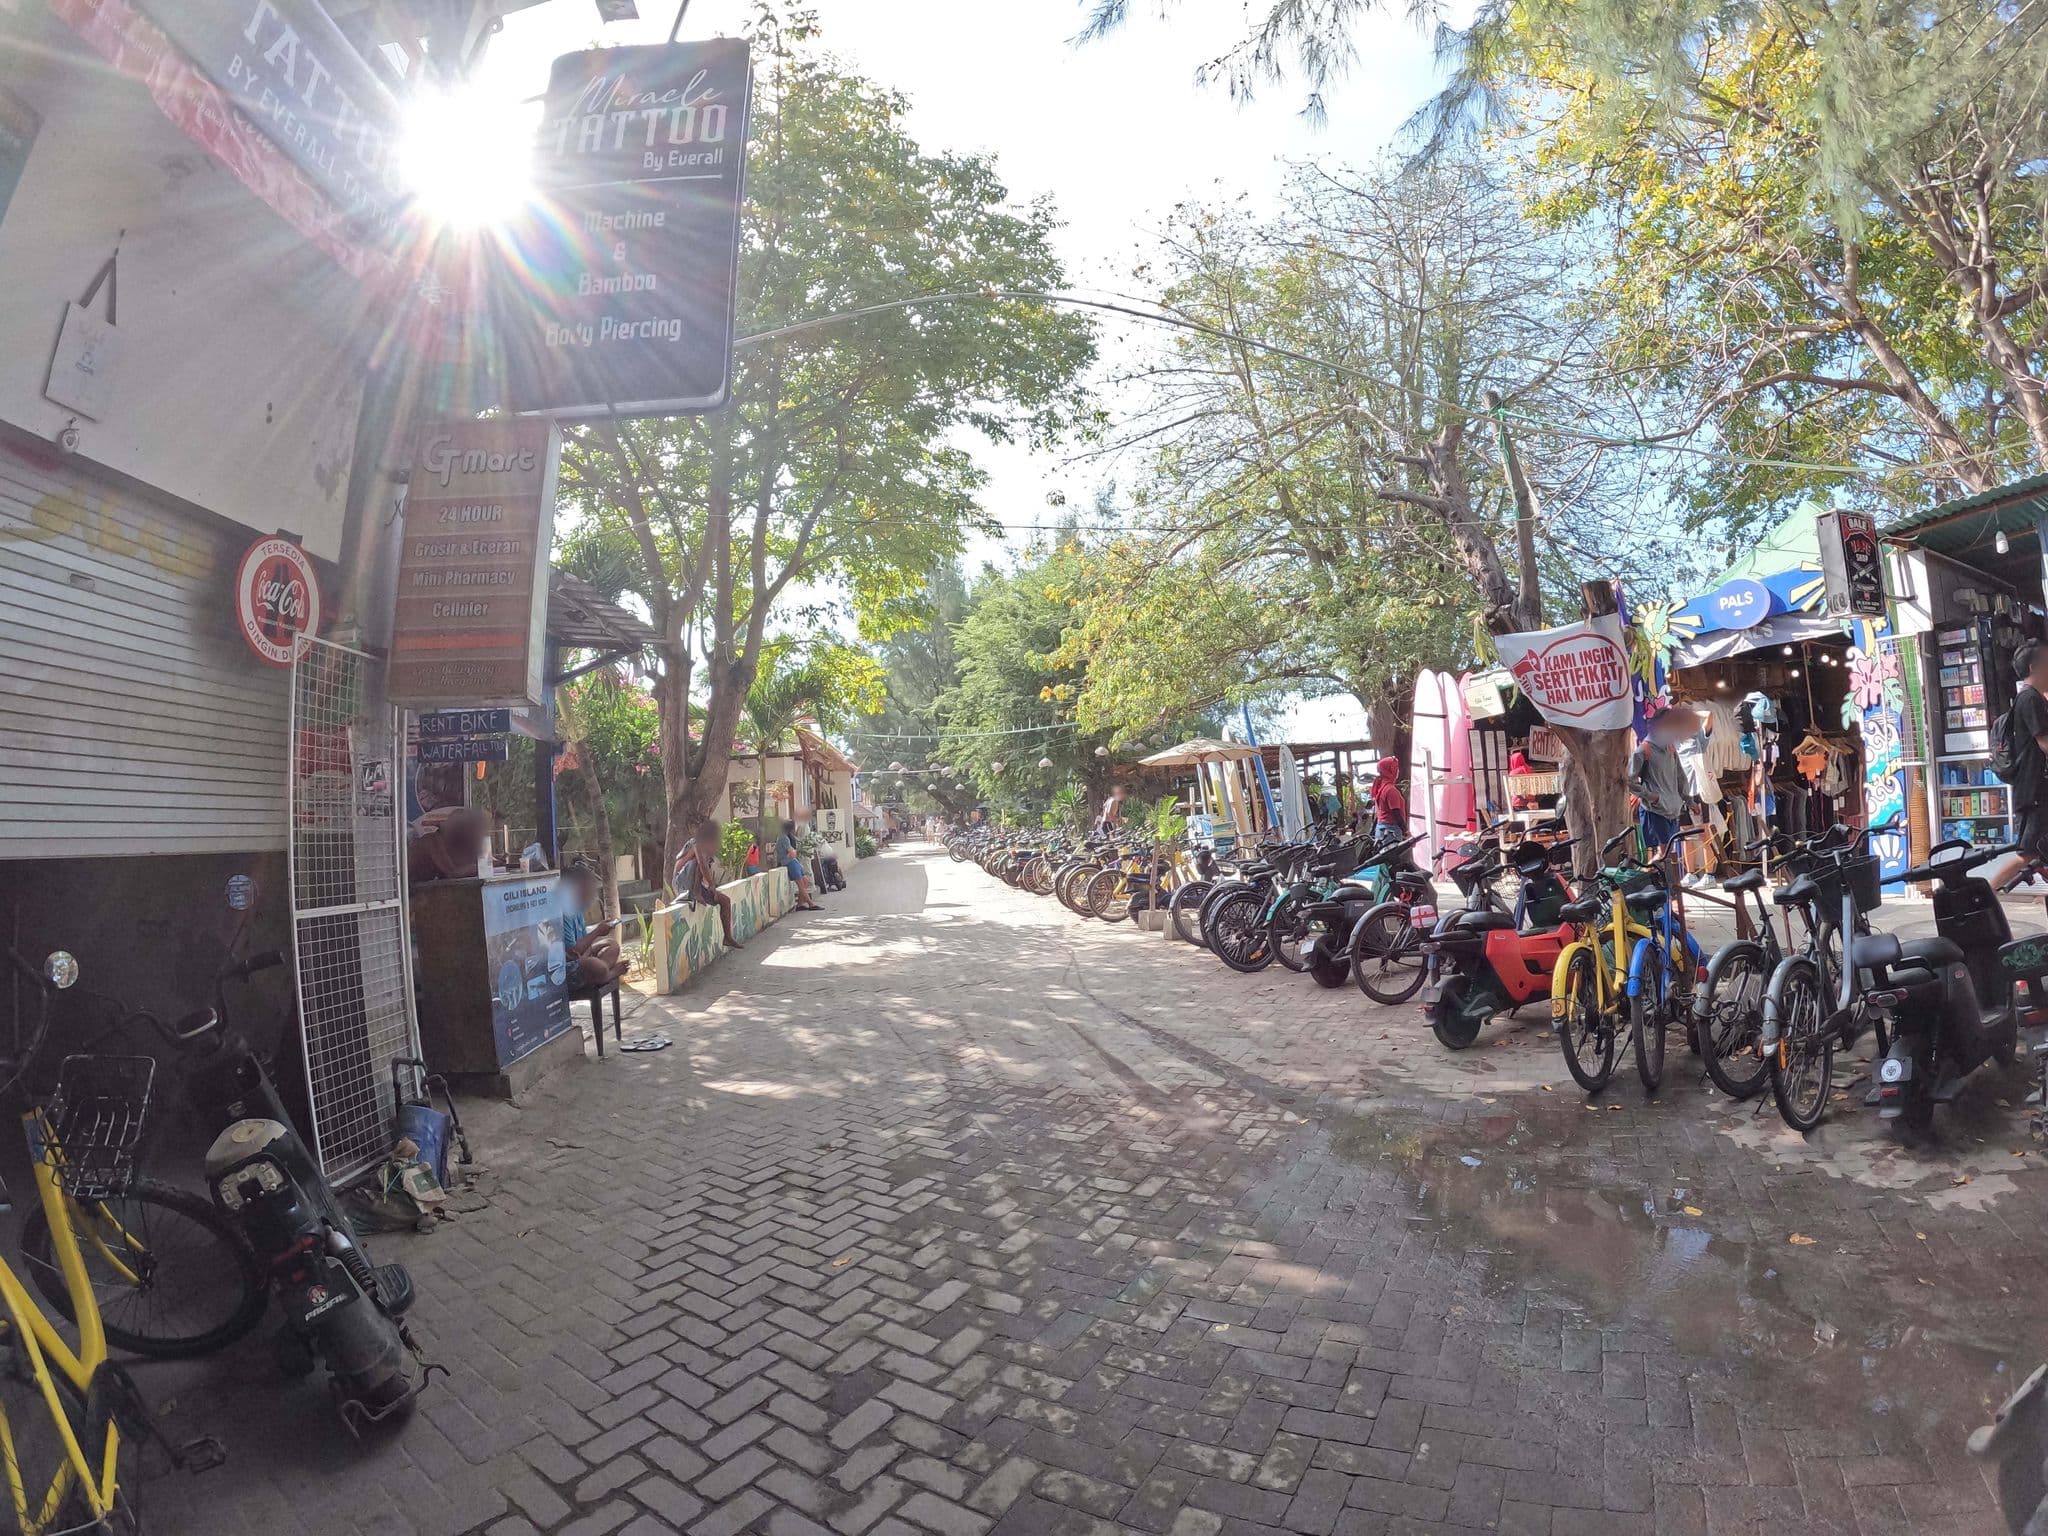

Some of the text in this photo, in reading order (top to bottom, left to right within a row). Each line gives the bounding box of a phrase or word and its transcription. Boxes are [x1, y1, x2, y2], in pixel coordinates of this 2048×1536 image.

[568, 68, 723, 119] Miracle
[227, 54, 259, 92] BY
[259, 86, 337, 178] EVERALL
[551, 103, 729, 158] TATTOO
[643, 147, 723, 171] By Everall
[583, 209, 666, 233] Machine
[577, 271, 657, 297] Bamboo
[600, 315, 682, 342] Piercing
[439, 504, 503, 524] 24 HOUR
[261, 543, 305, 570] TERSEDIA
[471, 538, 521, 555] Eceran
[412, 570, 517, 587] Mini Pharmacy
[1719, 590, 1755, 611] PALS
[246, 620, 278, 659] DINGIN
[1544, 645, 1615, 672] KAMI INGIN
[1546, 682, 1614, 705] HAK MILIK
[420, 709, 498, 733] RENT BIKE
[421, 742, 488, 761] WATERFALL
[1532, 731, 1550, 757] RENT
[503, 884, 548, 902] GILI ISLAND
